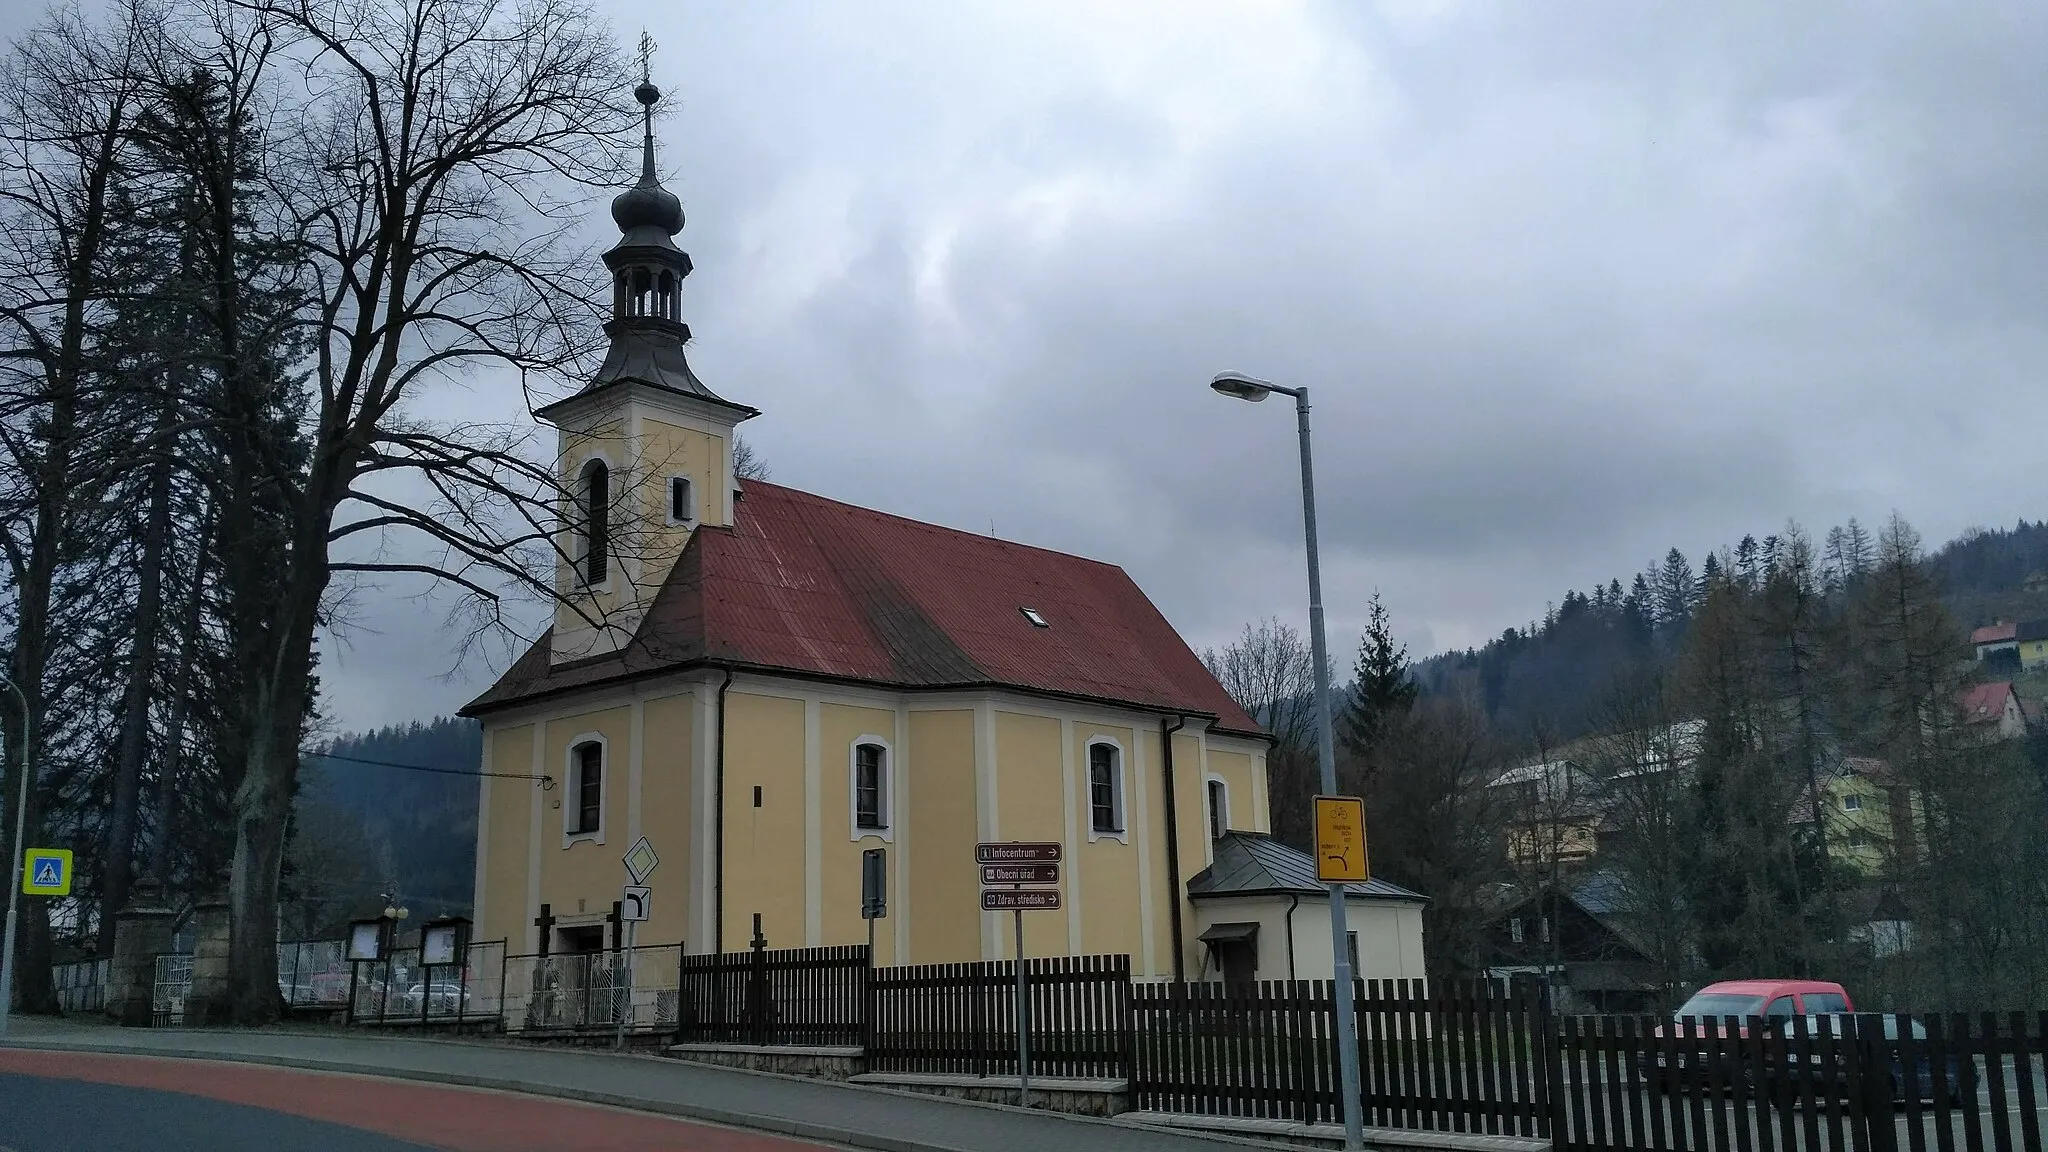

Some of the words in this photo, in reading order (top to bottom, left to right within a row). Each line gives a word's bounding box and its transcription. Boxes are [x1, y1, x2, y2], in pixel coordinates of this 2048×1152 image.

[992, 847, 1036, 858] Infocentrum
[996, 868, 1019, 879] Obecní
[997, 894, 1016, 905] Zdrav.
[1017, 894, 1046, 905] středisko
